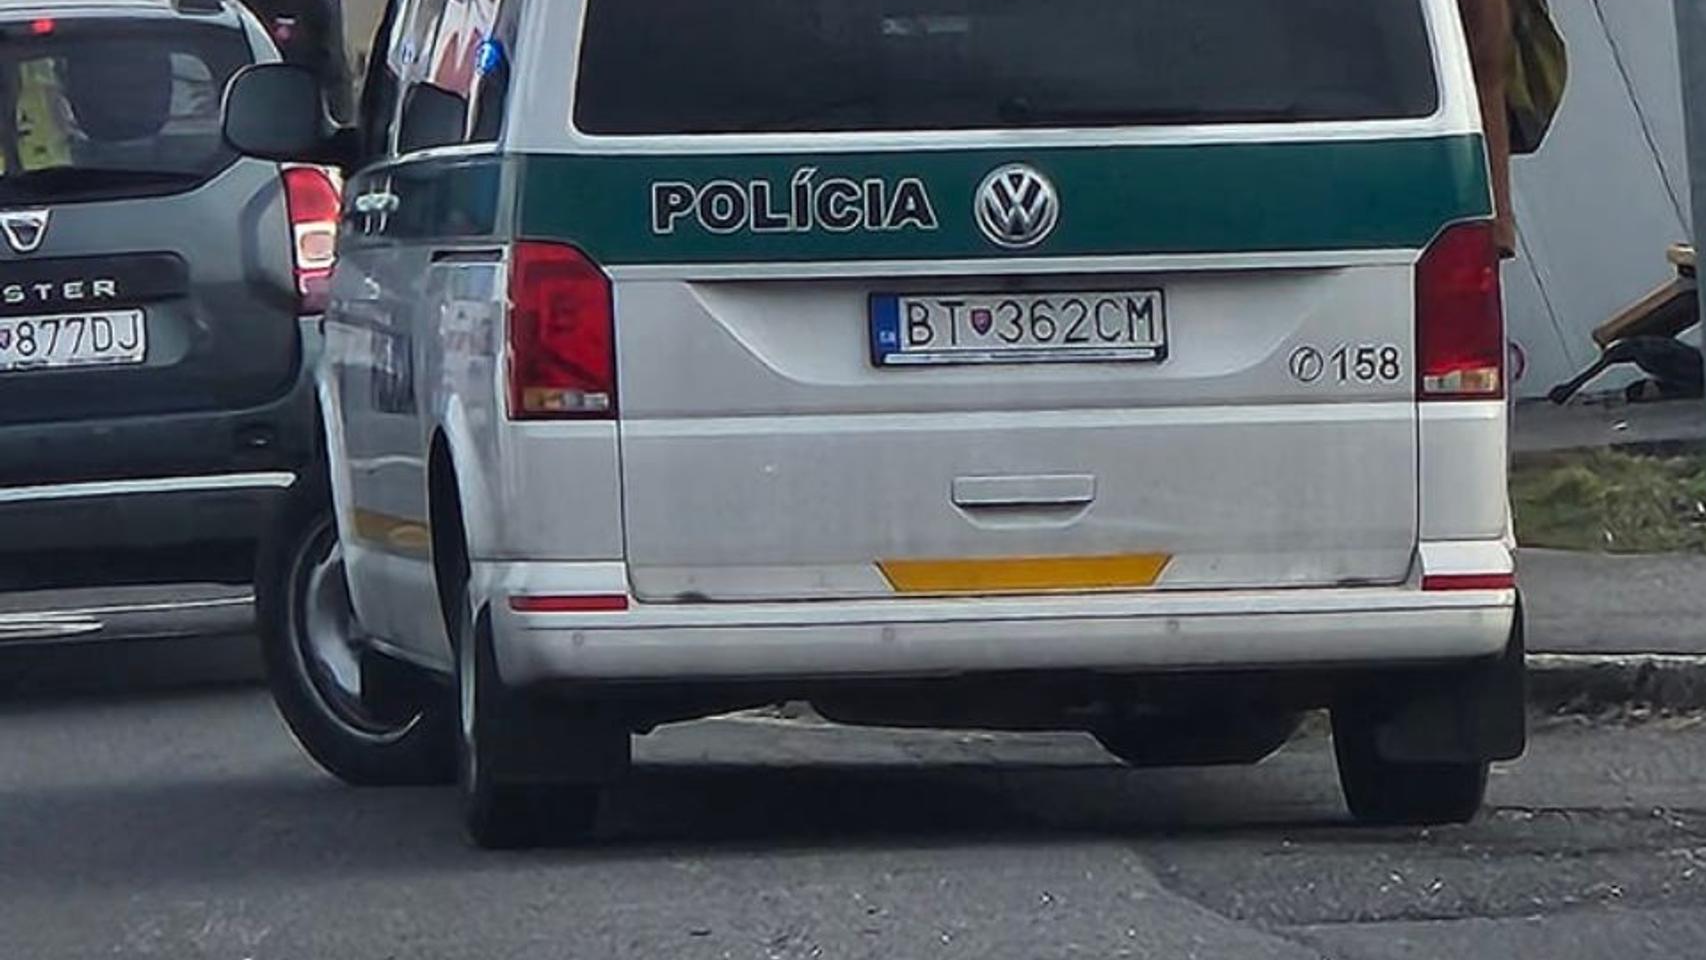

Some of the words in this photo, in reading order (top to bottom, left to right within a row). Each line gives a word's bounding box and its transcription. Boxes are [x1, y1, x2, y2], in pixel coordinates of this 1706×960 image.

[652, 166, 938, 234] POLÍCIA
[3, 280, 117, 303] STER
[16, 313, 138, 356] 877DJ
[906, 300, 964, 346] BT
[998, 297, 1155, 344] 362CM
[1330, 346, 1400, 381] 158
